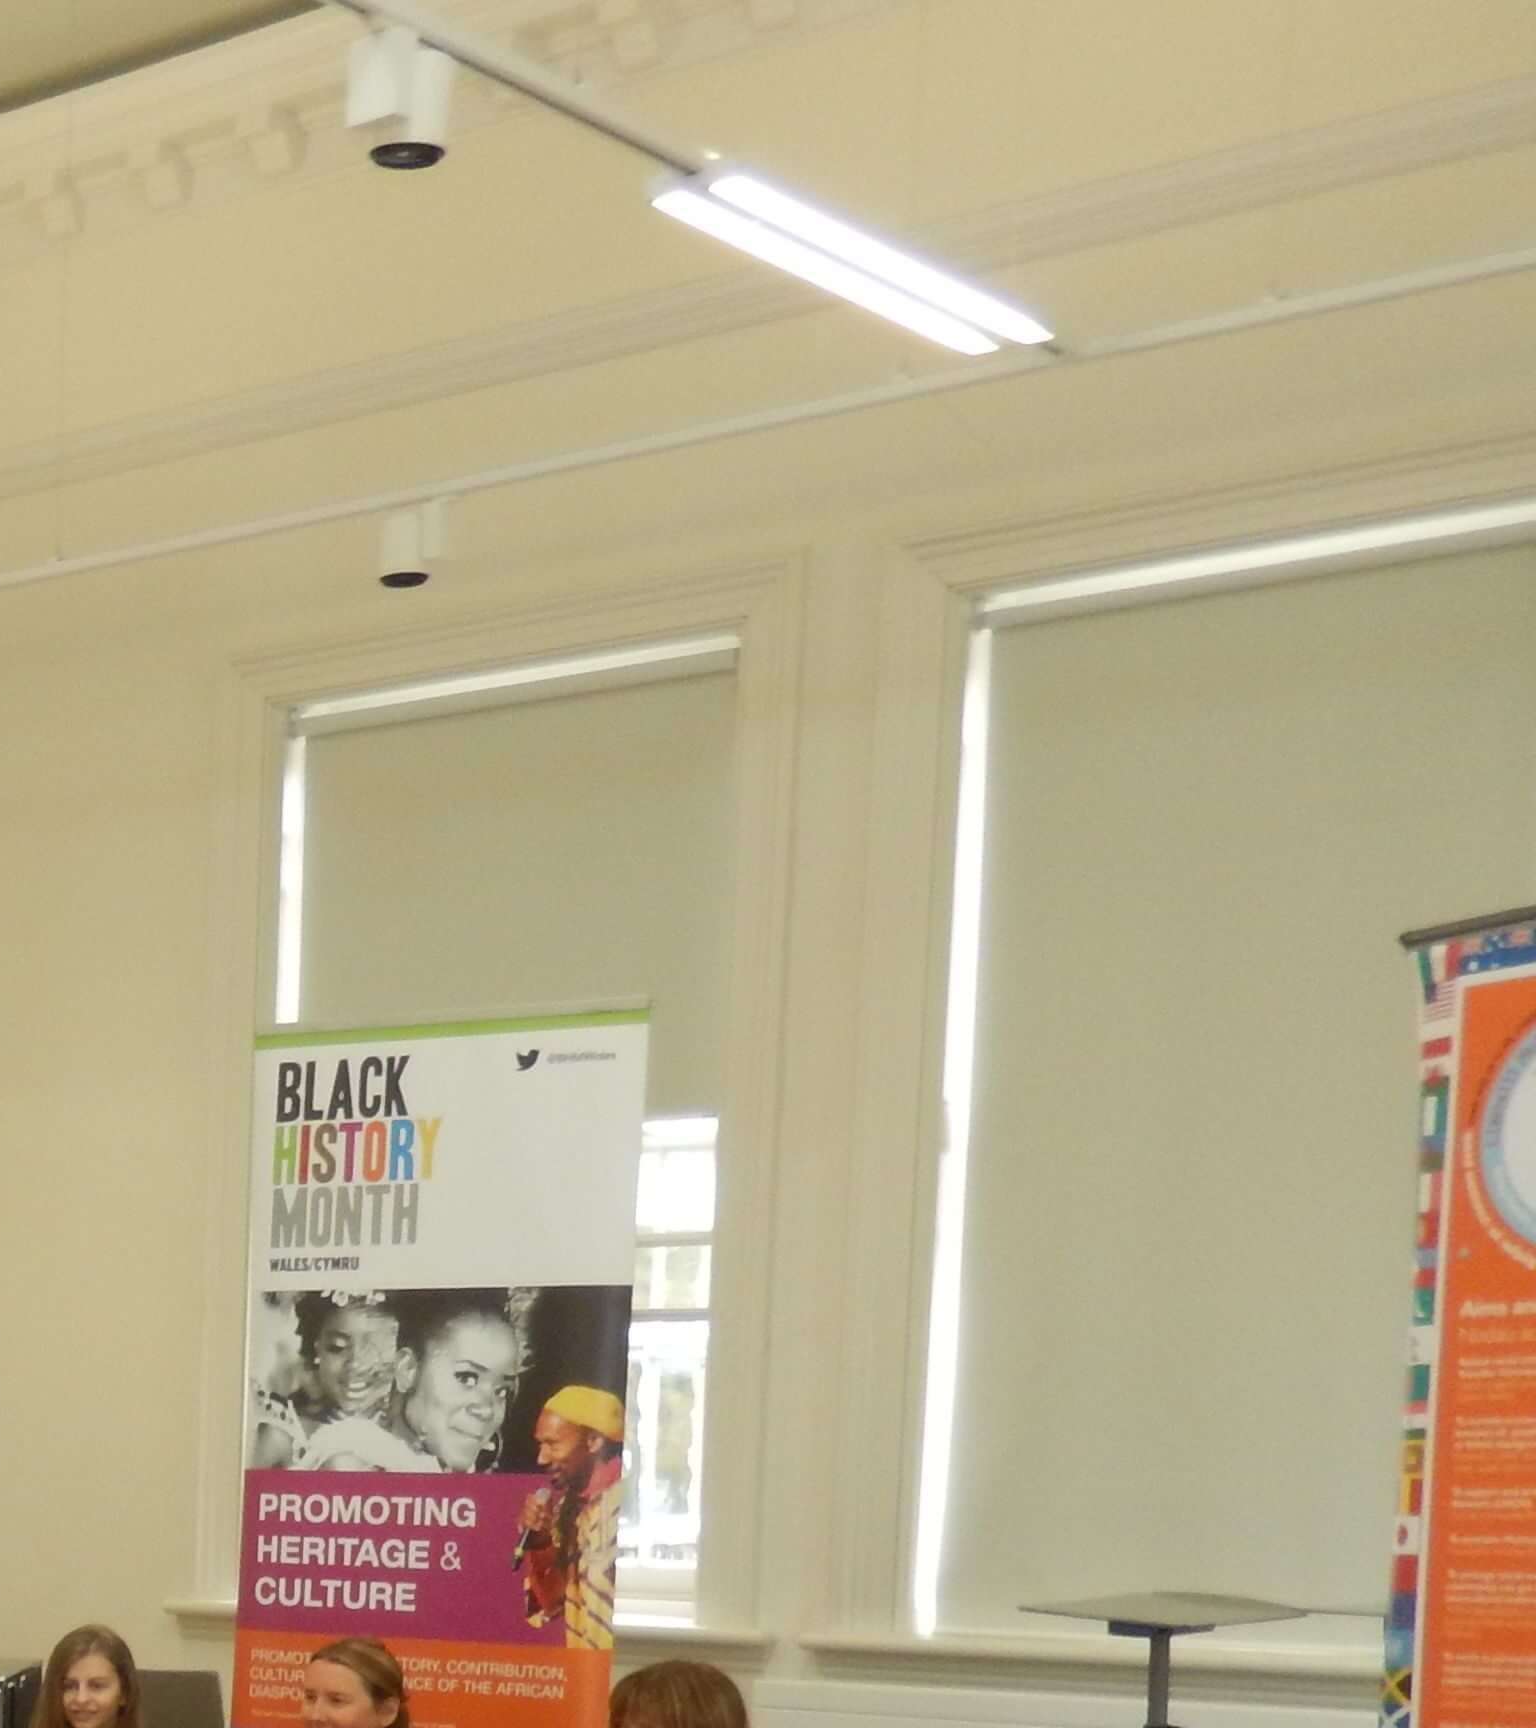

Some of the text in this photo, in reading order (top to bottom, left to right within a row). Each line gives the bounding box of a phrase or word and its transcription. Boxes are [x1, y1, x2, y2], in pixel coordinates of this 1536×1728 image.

[276, 1055, 410, 1122] BLACK
[273, 1116, 443, 1185] HISTORY
[270, 1184, 419, 1248] MONTH
[270, 1257, 360, 1271] WALES/CYMRU
[259, 1493, 477, 1528] PROMOTING
[257, 1535, 461, 1571] HERITAGE &
[255, 1576, 416, 1612] CULTURE
[251, 1649, 311, 1664] PROMOT
[447, 1660, 567, 1681] CONTRIBUTION,
[249, 1686, 305, 1701] DIASPO
[250, 1668, 305, 1683] CULTUR
[438, 1679, 458, 1692] OF
[463, 1680, 491, 1694] THE
[496, 1682, 564, 1699] AFRICAN
